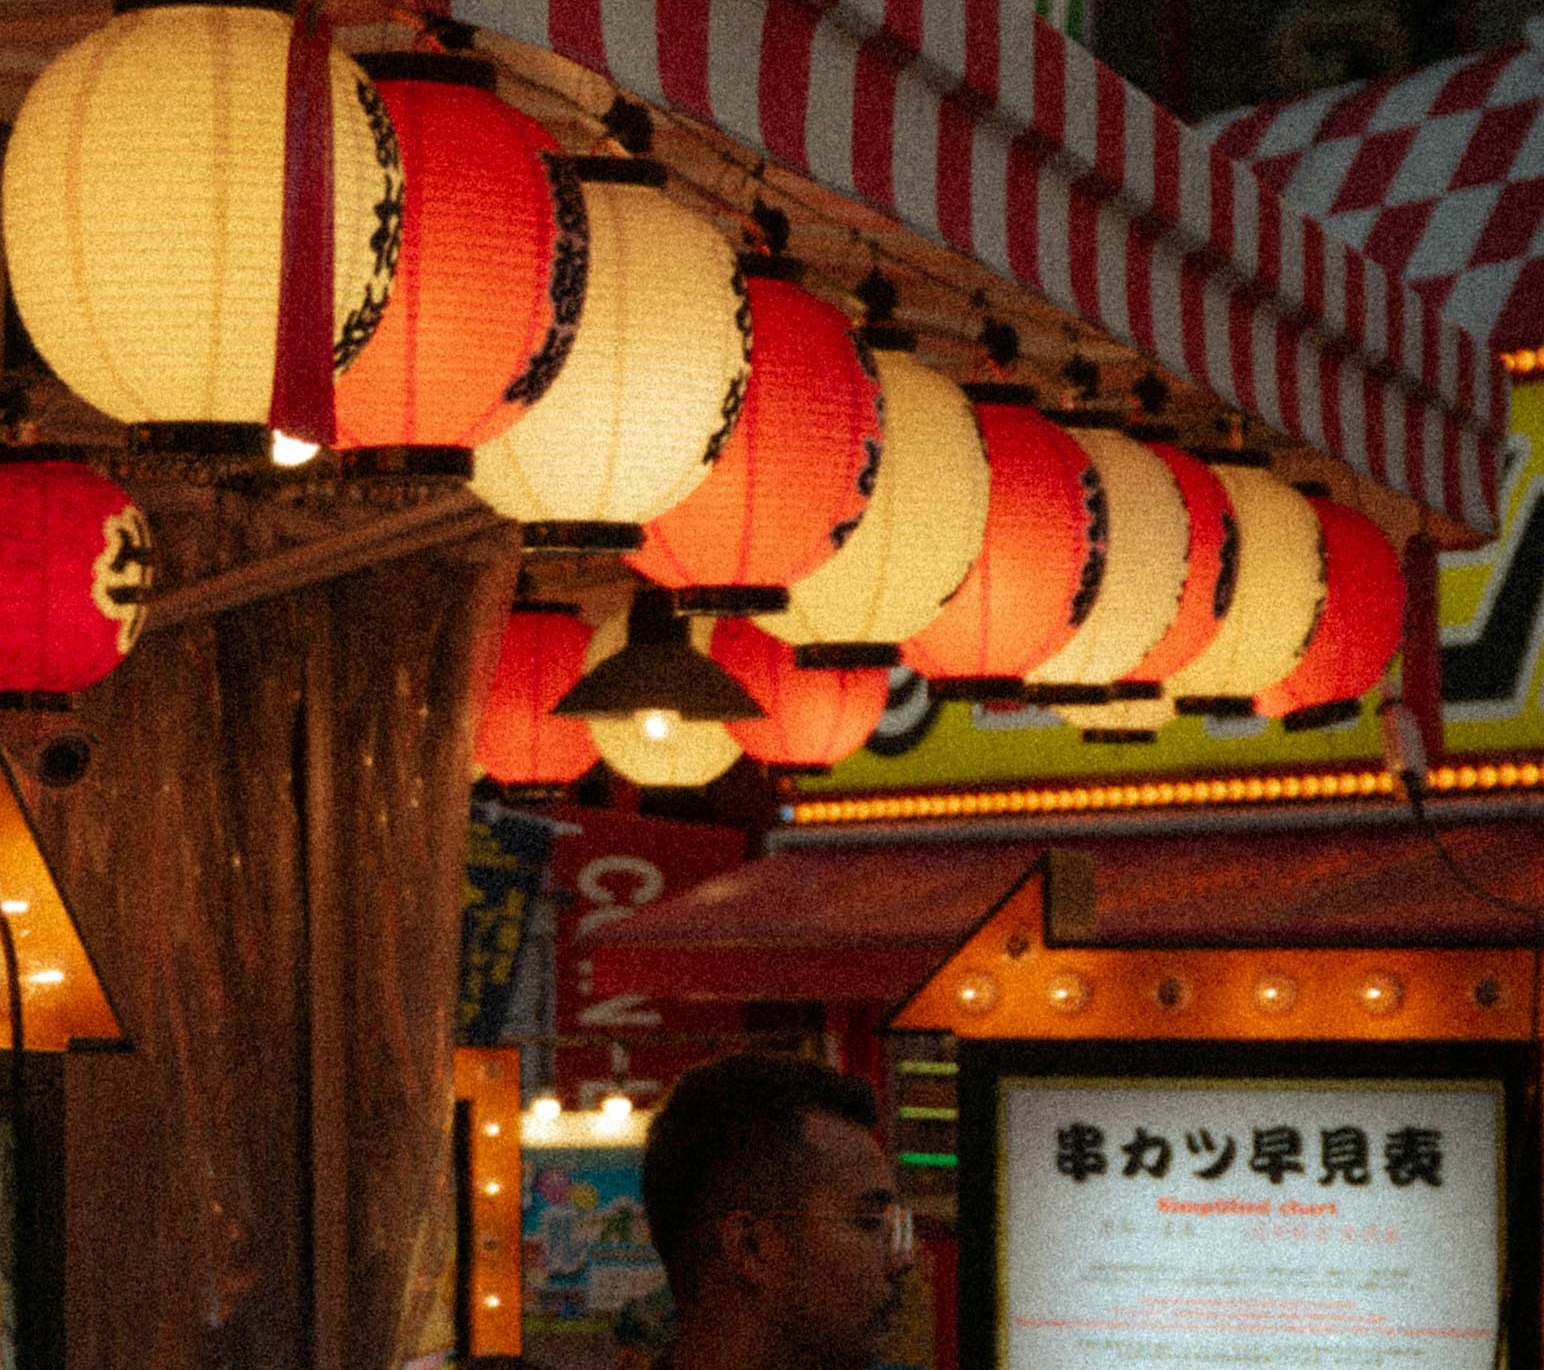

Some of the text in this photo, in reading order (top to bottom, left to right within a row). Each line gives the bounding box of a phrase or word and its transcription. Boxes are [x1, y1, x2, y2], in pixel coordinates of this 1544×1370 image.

[1056, 1122, 1445, 1187] 串カツ早見表
[1157, 1196, 1338, 1217] Simplified chart
